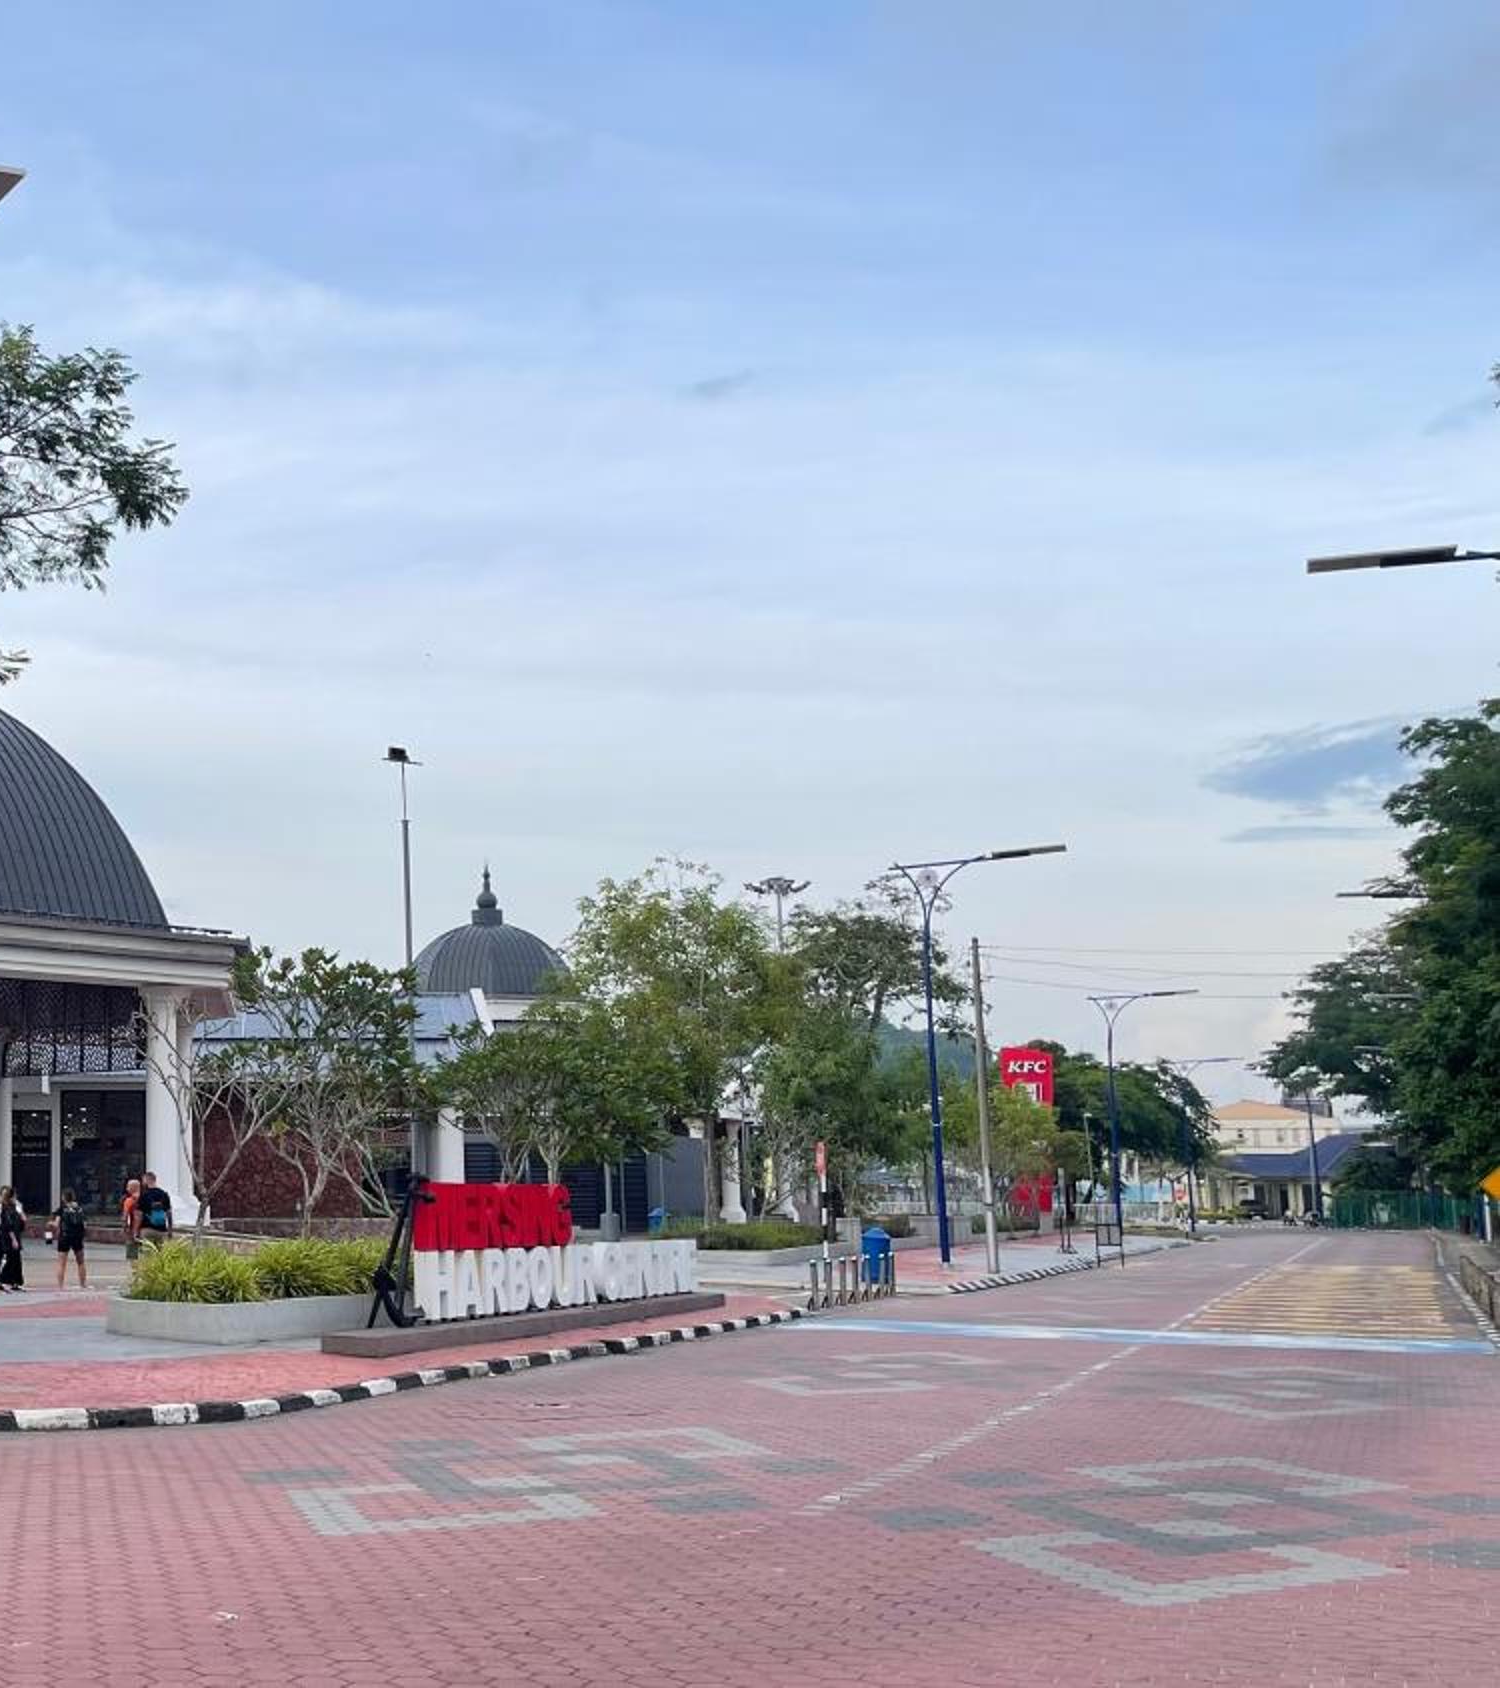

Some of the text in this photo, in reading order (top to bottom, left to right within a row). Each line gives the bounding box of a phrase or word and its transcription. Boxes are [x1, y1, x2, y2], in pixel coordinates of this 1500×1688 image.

[1008, 1060, 1047, 1073] KFC
[414, 1183, 573, 1250] MERSING
[414, 1244, 597, 1321] HARBOUR
